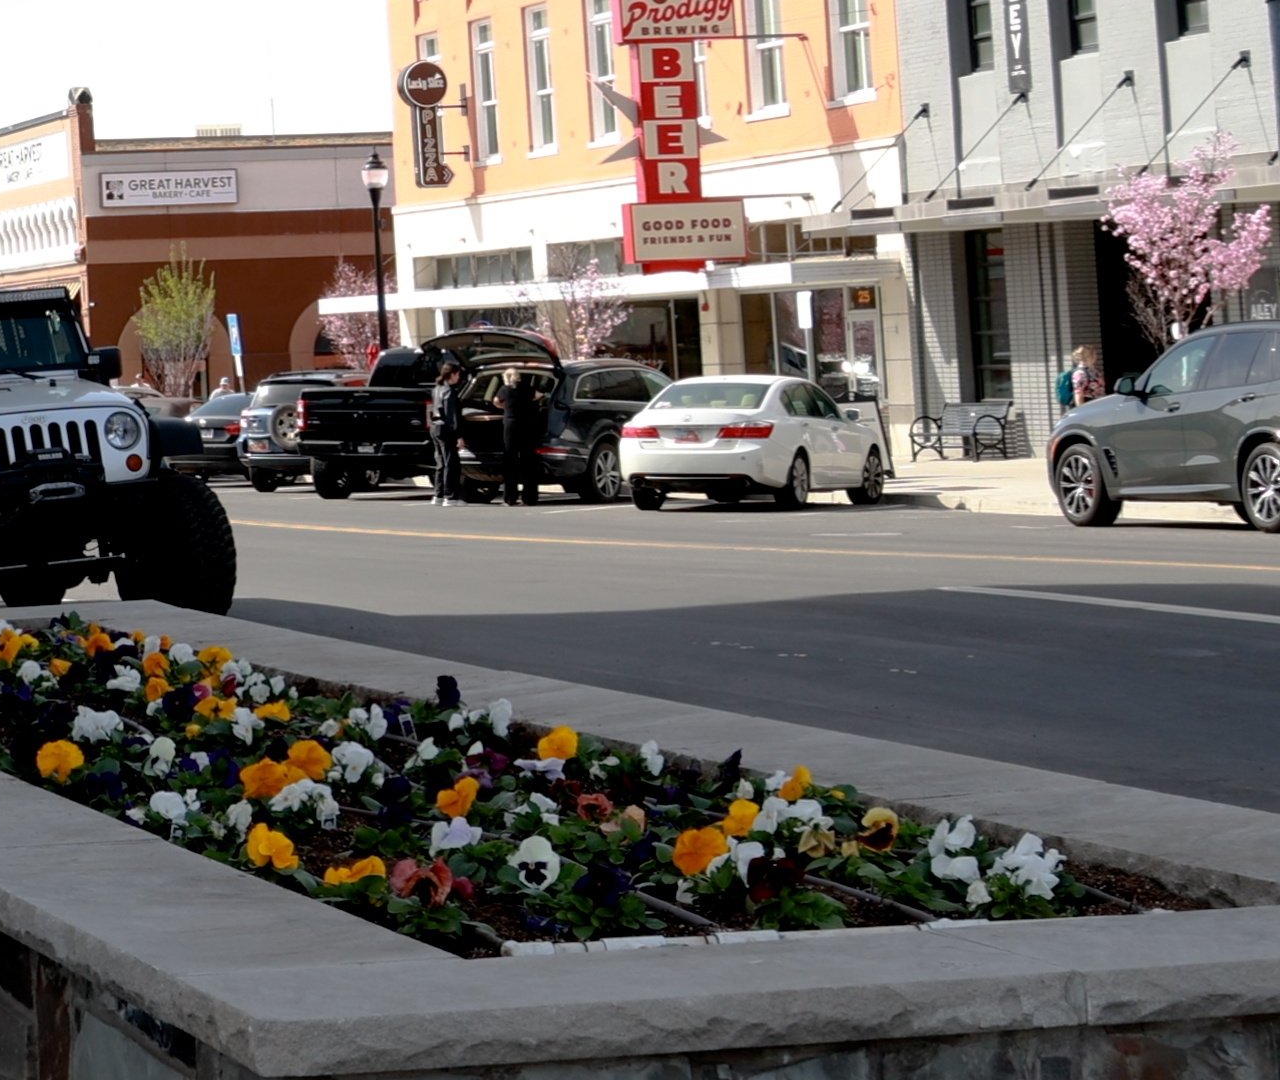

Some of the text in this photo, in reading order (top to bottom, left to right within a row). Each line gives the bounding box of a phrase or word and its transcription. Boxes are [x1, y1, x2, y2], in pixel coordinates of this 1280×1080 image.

[641, 24, 720, 36] BREWING
[407, 78, 428, 90] Lucky
[652, 47, 690, 195] BEER
[421, 108, 438, 182] PIZZA
[128, 176, 233, 191] GREAT HARVEST
[152, 189, 211, 199] BAKERY CAFE
[642, 217, 733, 231] GOOD FOOD
[643, 233, 732, 245] FRIENDS & FUN
